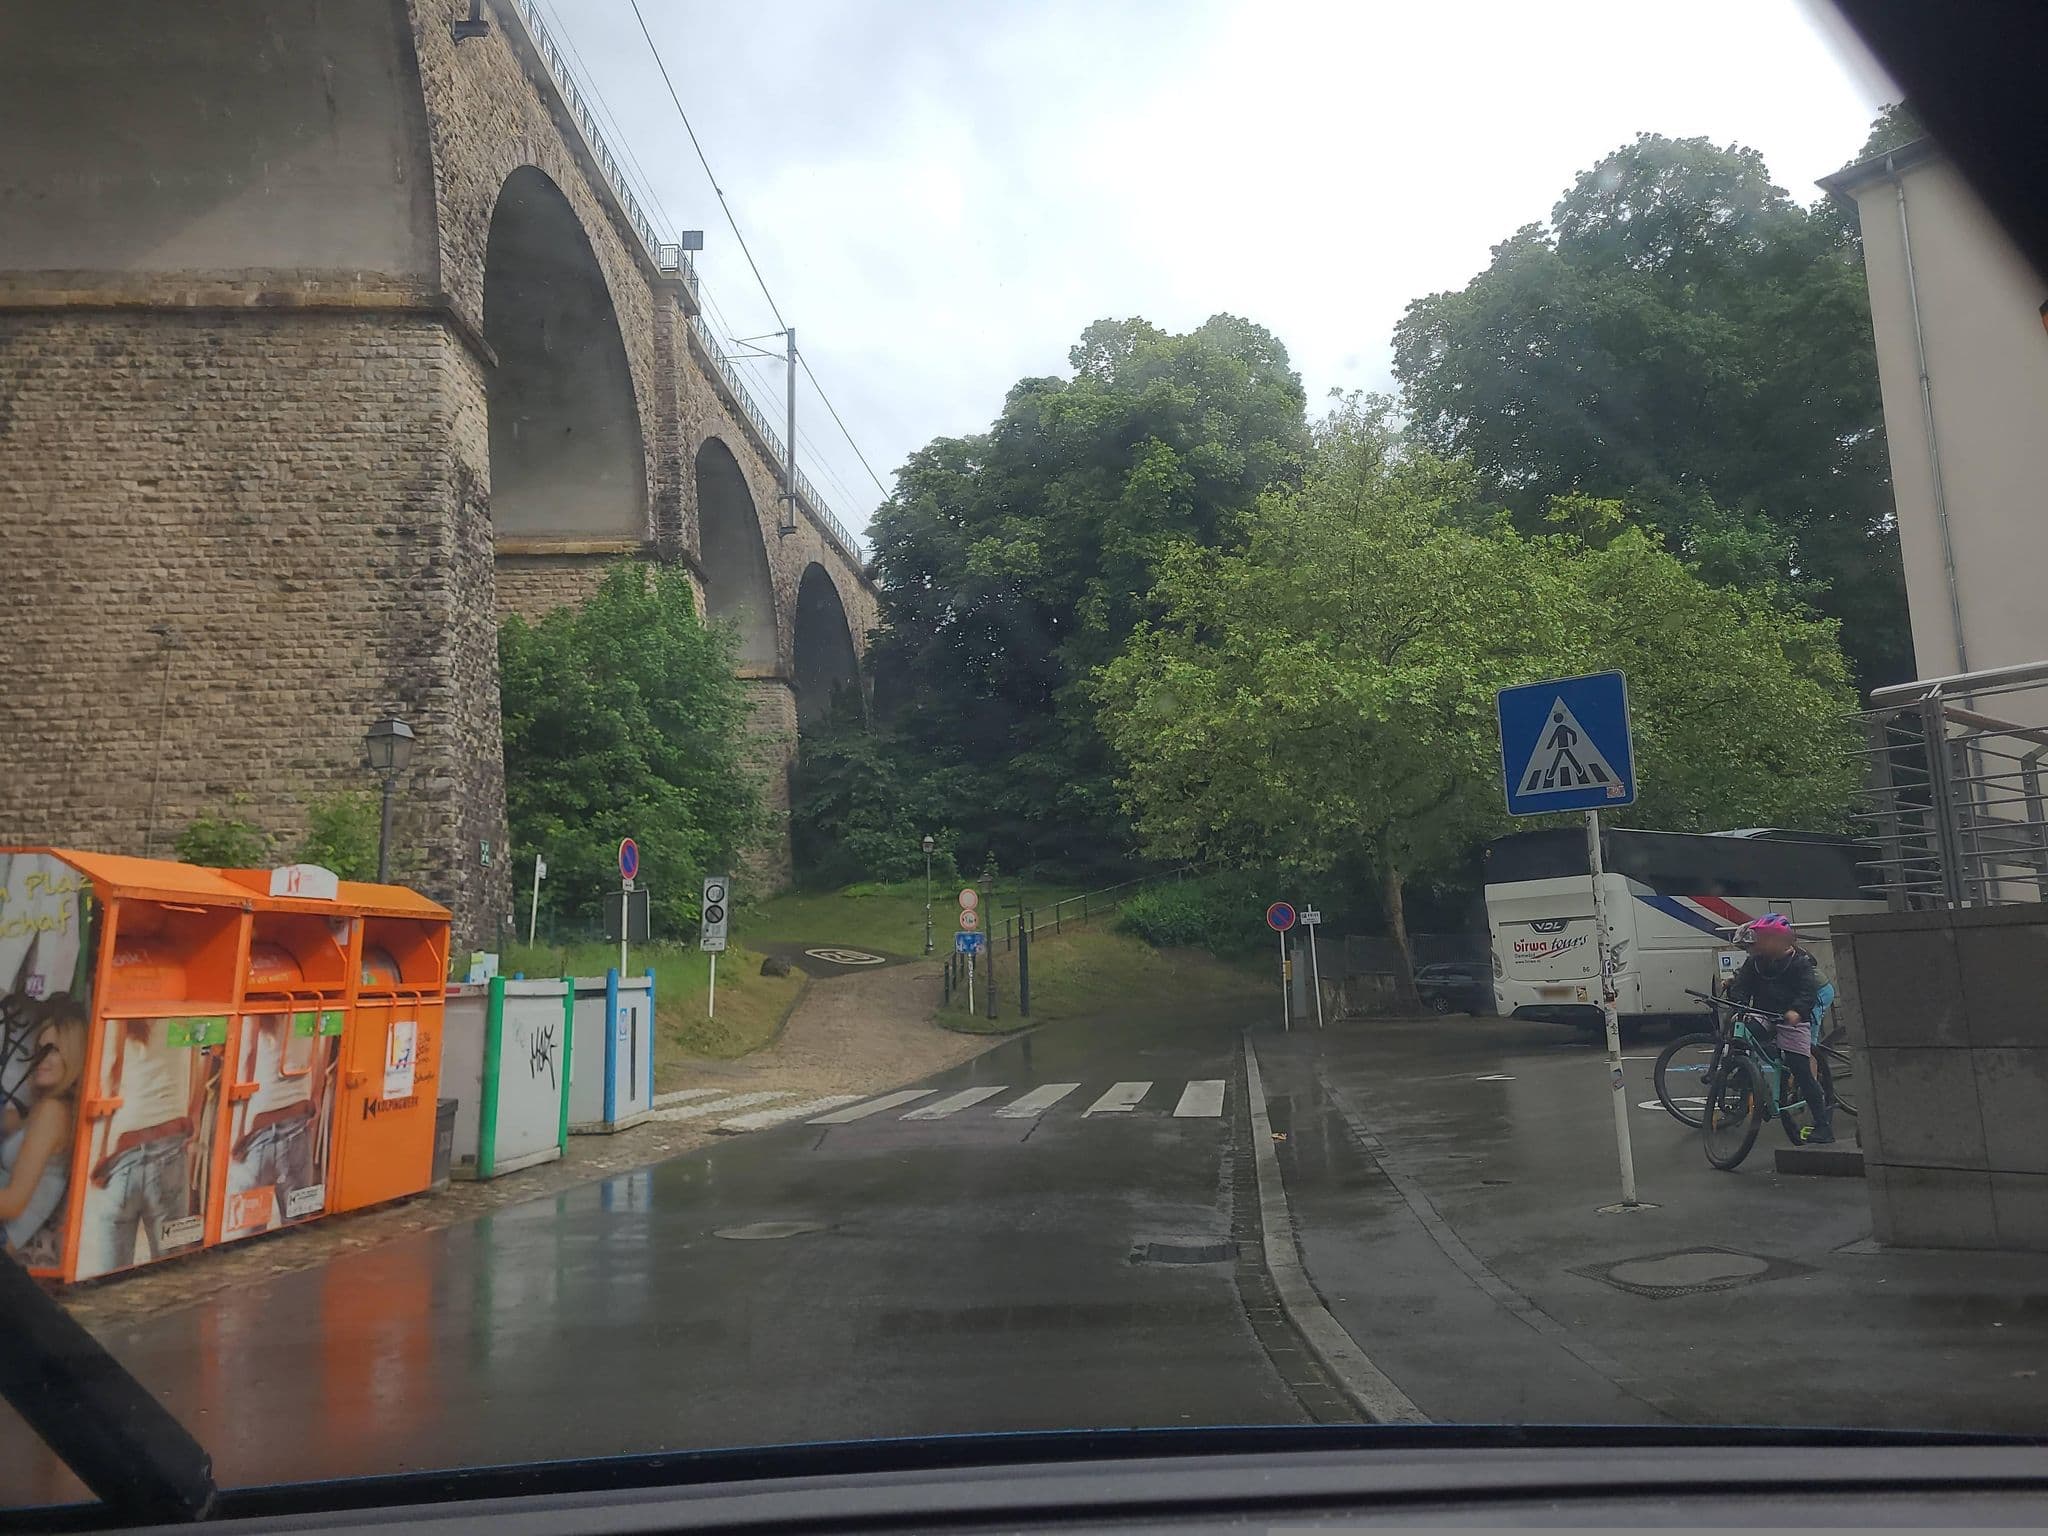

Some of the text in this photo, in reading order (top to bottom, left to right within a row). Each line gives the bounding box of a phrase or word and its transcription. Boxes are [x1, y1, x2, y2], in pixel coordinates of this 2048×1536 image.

[1535, 921, 1562, 931] VDL
[1514, 935, 1588, 952] birwa tours
